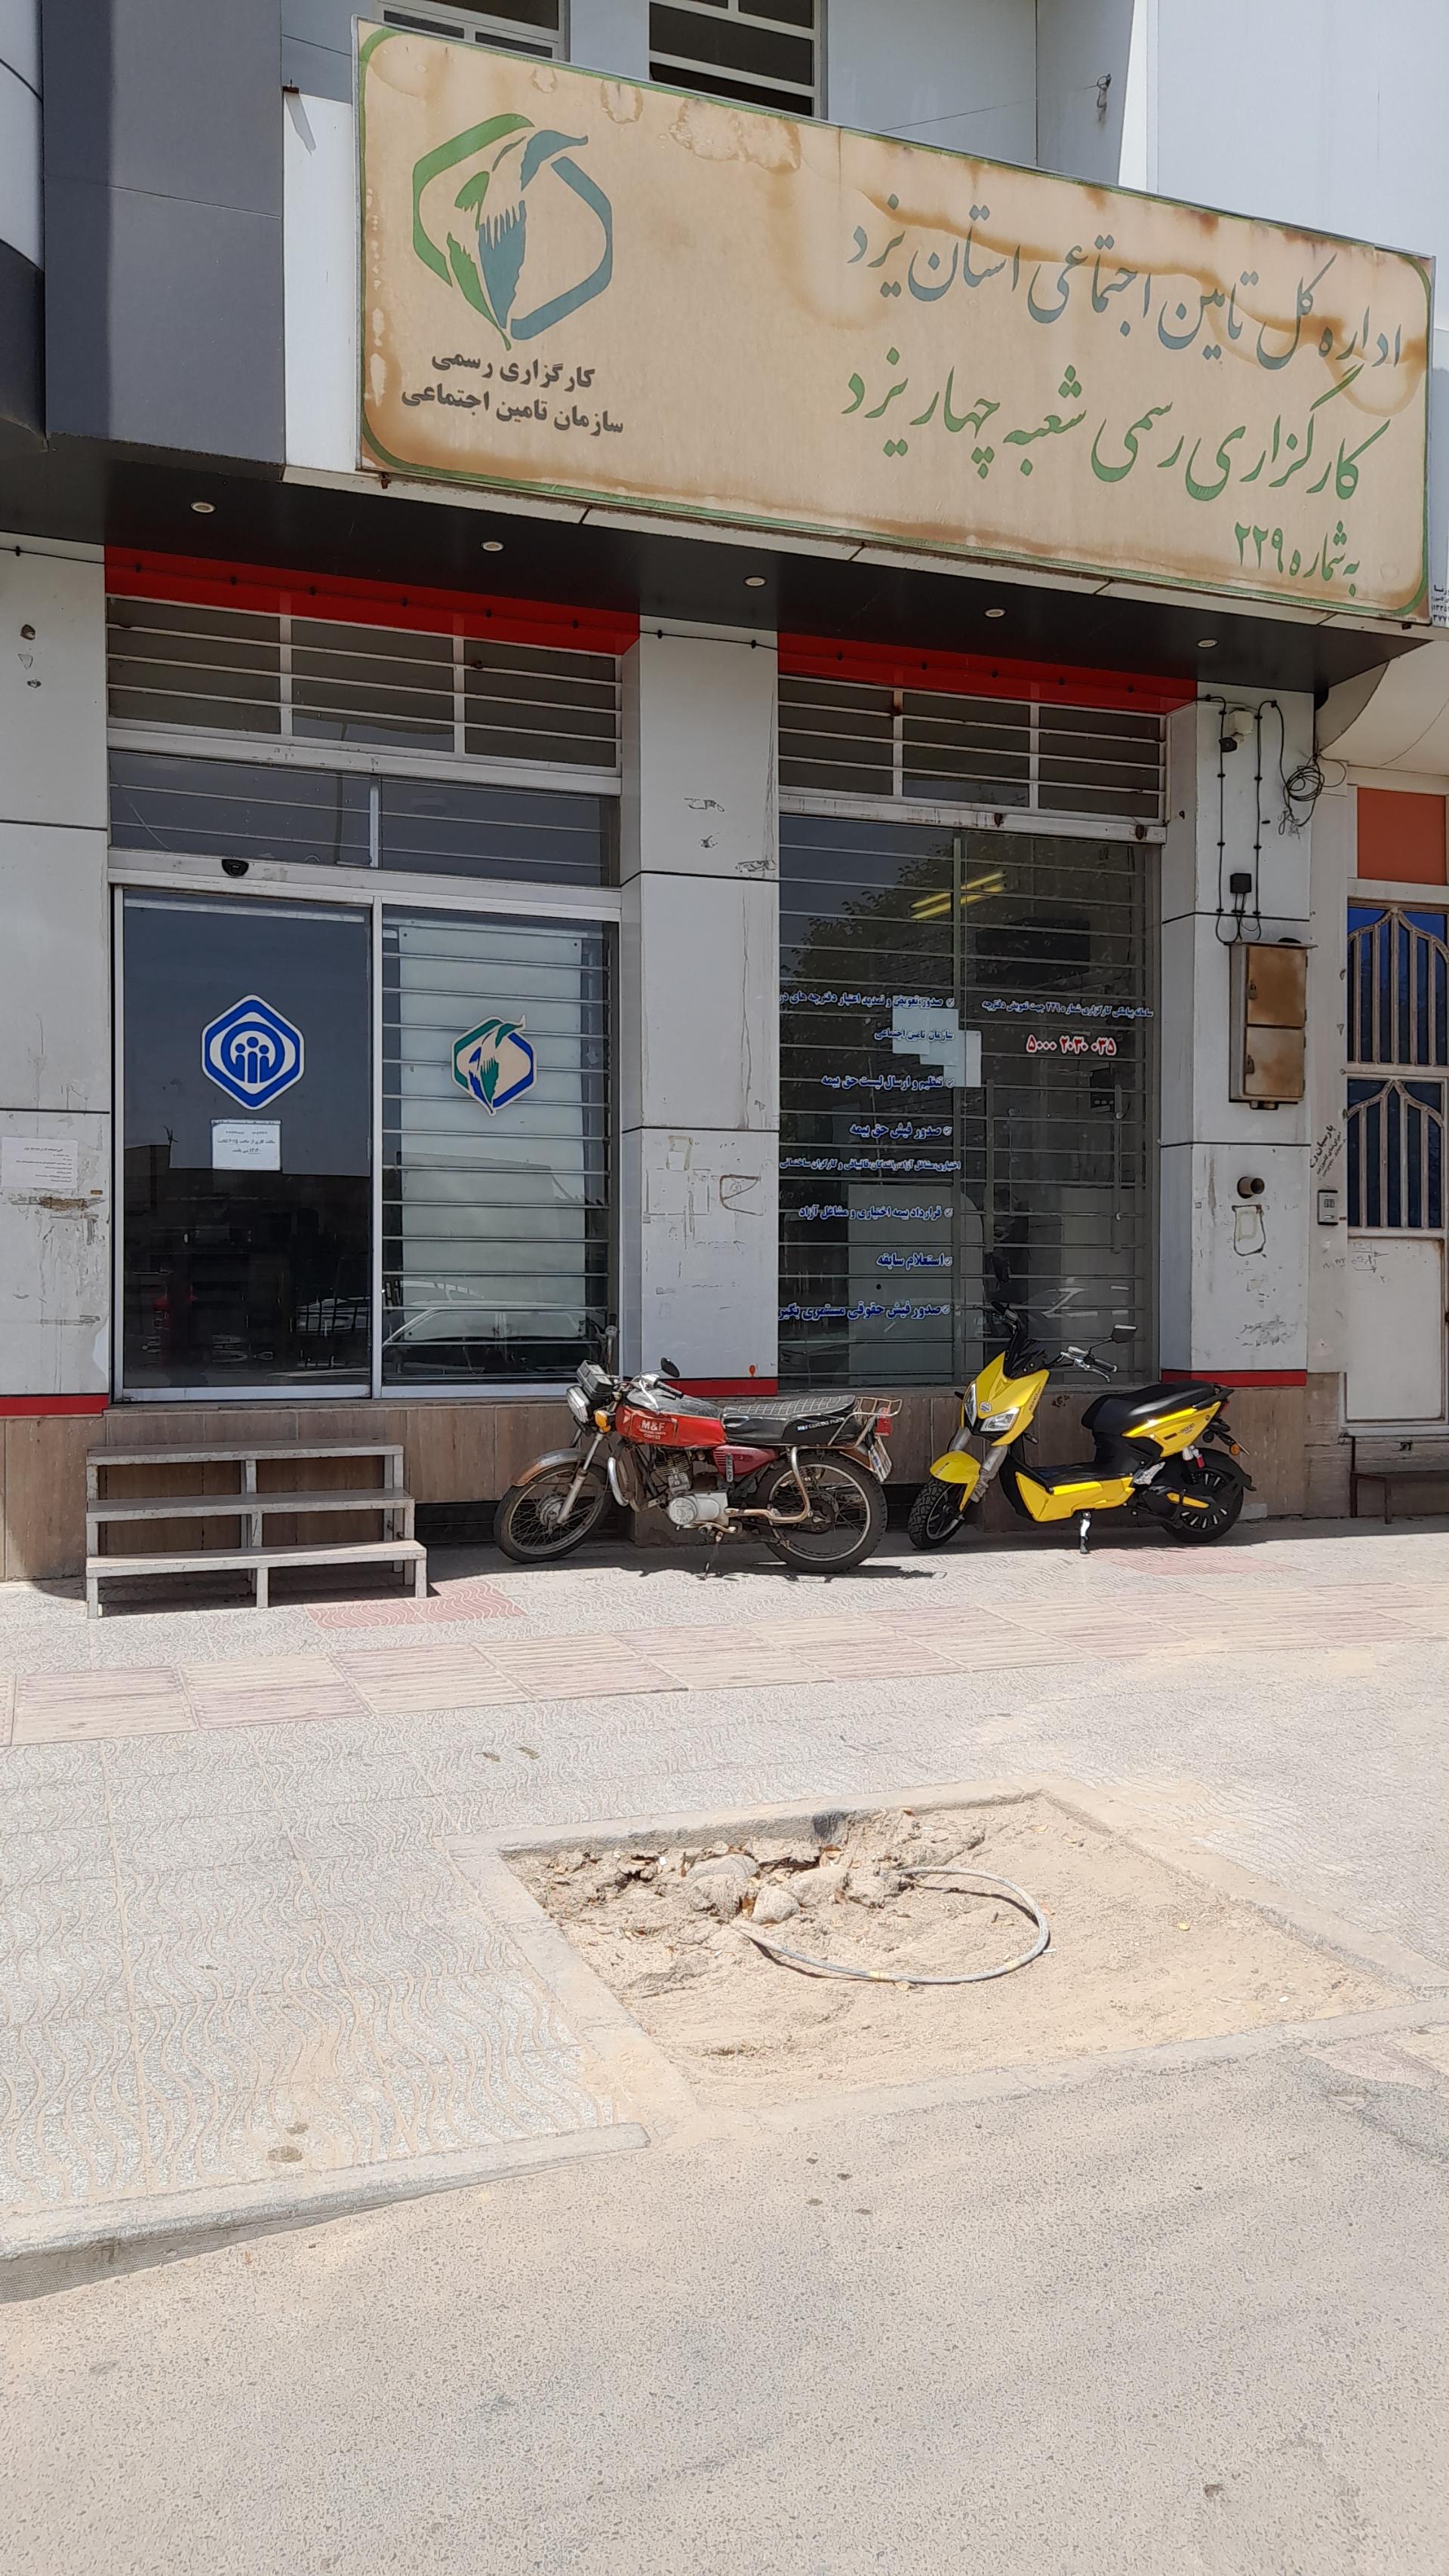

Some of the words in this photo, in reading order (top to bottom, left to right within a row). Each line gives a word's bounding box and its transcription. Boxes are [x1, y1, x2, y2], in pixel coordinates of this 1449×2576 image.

[848, 194, 905, 298] یزد
[908, 205, 1020, 301] استان
[1027, 234, 1151, 337] اجتماعی
[1158, 272, 1259, 360] تامین
[1257, 254, 1337, 370] کل
[1318, 307, 1401, 367] اداره
[432, 353, 494, 378] رسمی
[499, 359, 595, 392] کارگزاری
[401, 383, 490, 416] اجتماعی
[841, 348, 908, 457] یزد
[496, 399, 548, 423] تامین
[554, 405, 623, 436] سازمان
[910, 367, 1000, 478] چهار
[1003, 365, 1087, 476] شعبه
[1091, 402, 1184, 482] رسمی
[1235, 522, 1284, 574] ۲۲۹
[789, 990, 808, 1004] های
[808, 990, 838, 1005] دفترچه
[838, 992, 861, 1006] اعتبار
[874, 1027, 906, 1041] اجتماعی
[928, 1029, 954, 1042] سازمان
[1026, 1034, 1057, 1053] ۵۰۰۰
[821, 1075, 841, 1088] بیمه
[842, 1076, 858, 1090] حق
[860, 1075, 884, 1090] لیست
[884, 1076, 912, 1091] ارسال
[912, 1079, 918, 1091] و
[918, 1076, 943, 1091] تنظیم
[850, 1122, 871, 1138] بیمه
[871, 1123, 888, 1138] حق
[890, 1121, 912, 1138] فیش
[914, 1124, 941, 1139] صدور
[798, 1204, 819, 1220] آزاد
[820, 1205, 849, 1220] مشاغل
[850, 1209, 856, 1220] و
[857, 1205, 891, 1220] اختیاری
[892, 1207, 909, 1220] بیمه
[910, 1206, 942, 1220] قرارداد
[876, 1252, 904, 1270] سابقه
[906, 1253, 944, 1270] استعلام
[803, 1305, 845, 1321] مستمری
[848, 1301, 884, 1319] حقوقی
[887, 1301, 911, 1318] فیش
[912, 1305, 942, 1320] صدور
[641, 1420, 666, 1431] M&F
